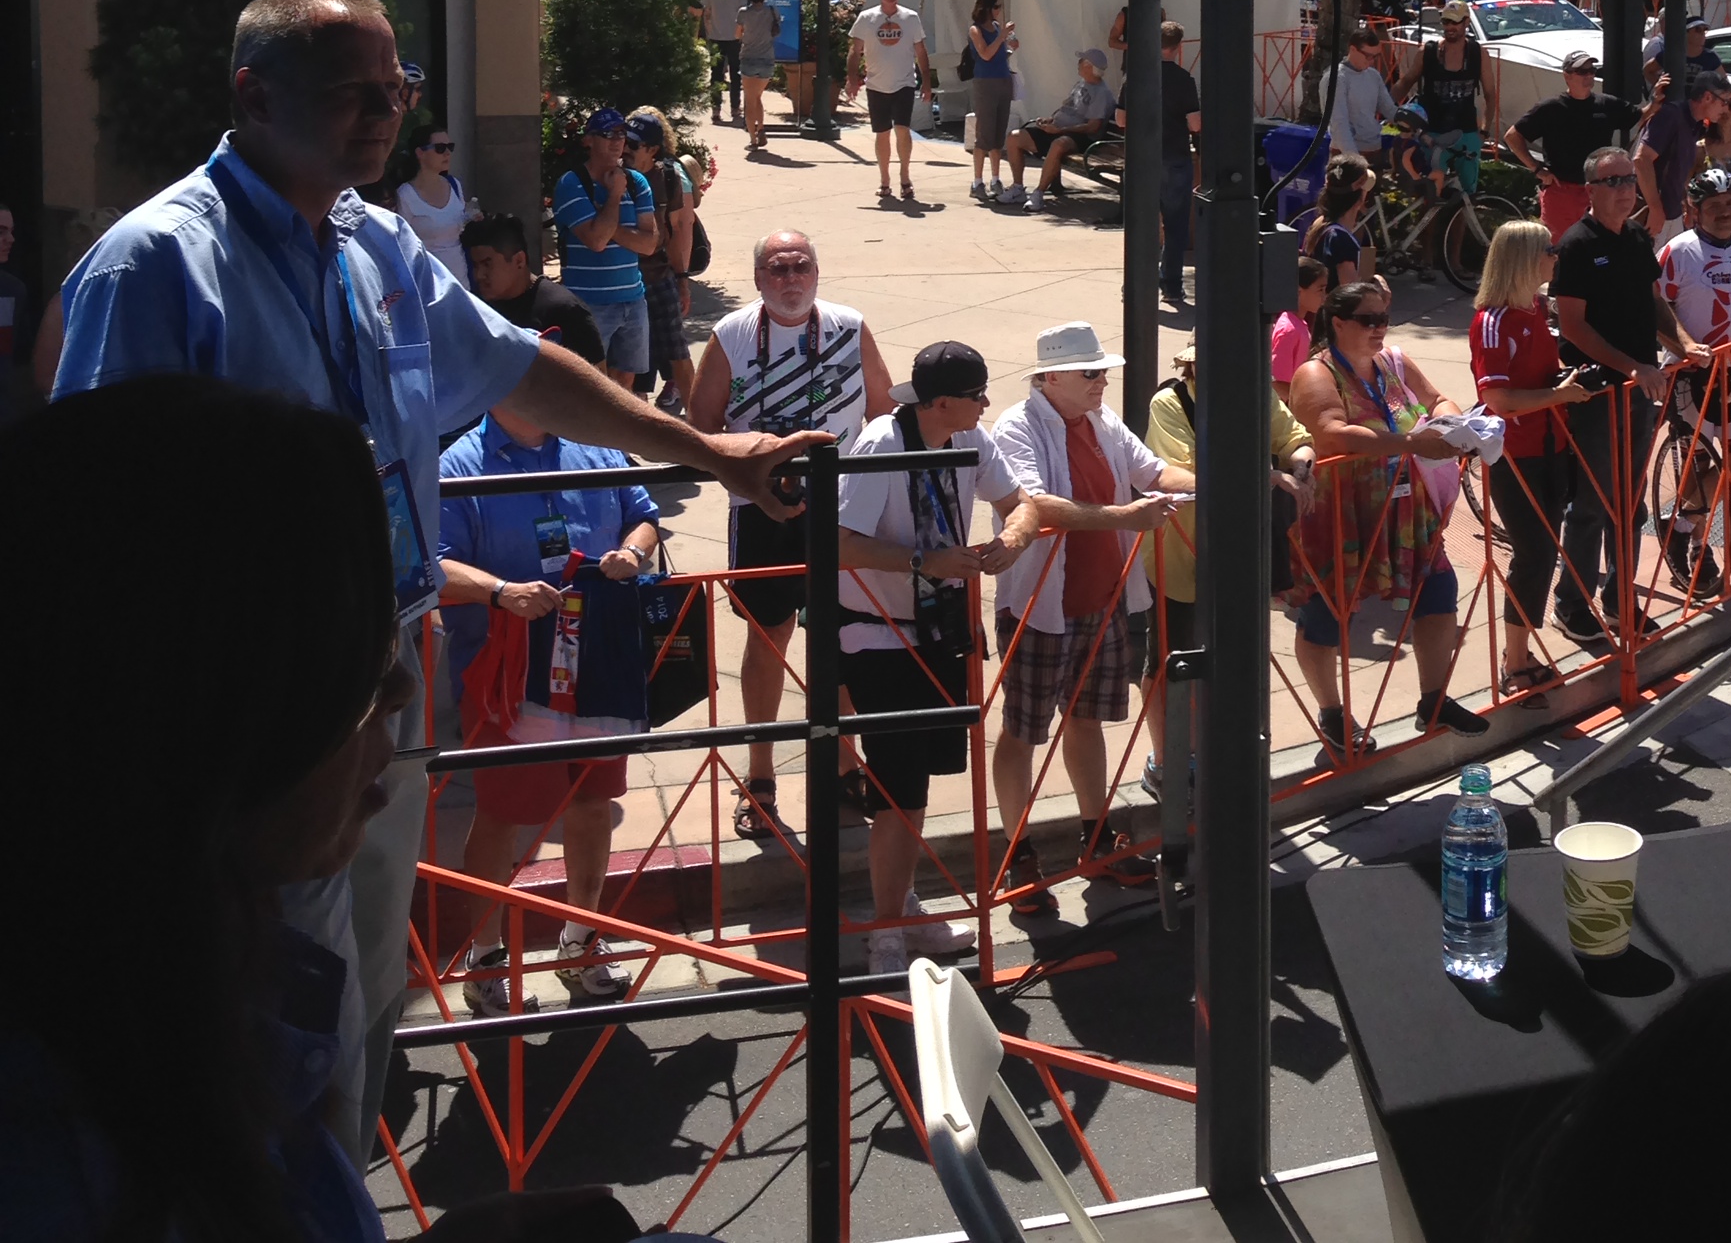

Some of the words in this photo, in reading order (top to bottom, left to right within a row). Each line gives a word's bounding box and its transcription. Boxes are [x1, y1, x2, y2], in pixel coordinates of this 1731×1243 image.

[877, 29, 902, 39] Gulf
[423, 560, 433, 587] STAFF
[657, 595, 668, 622] 2014
